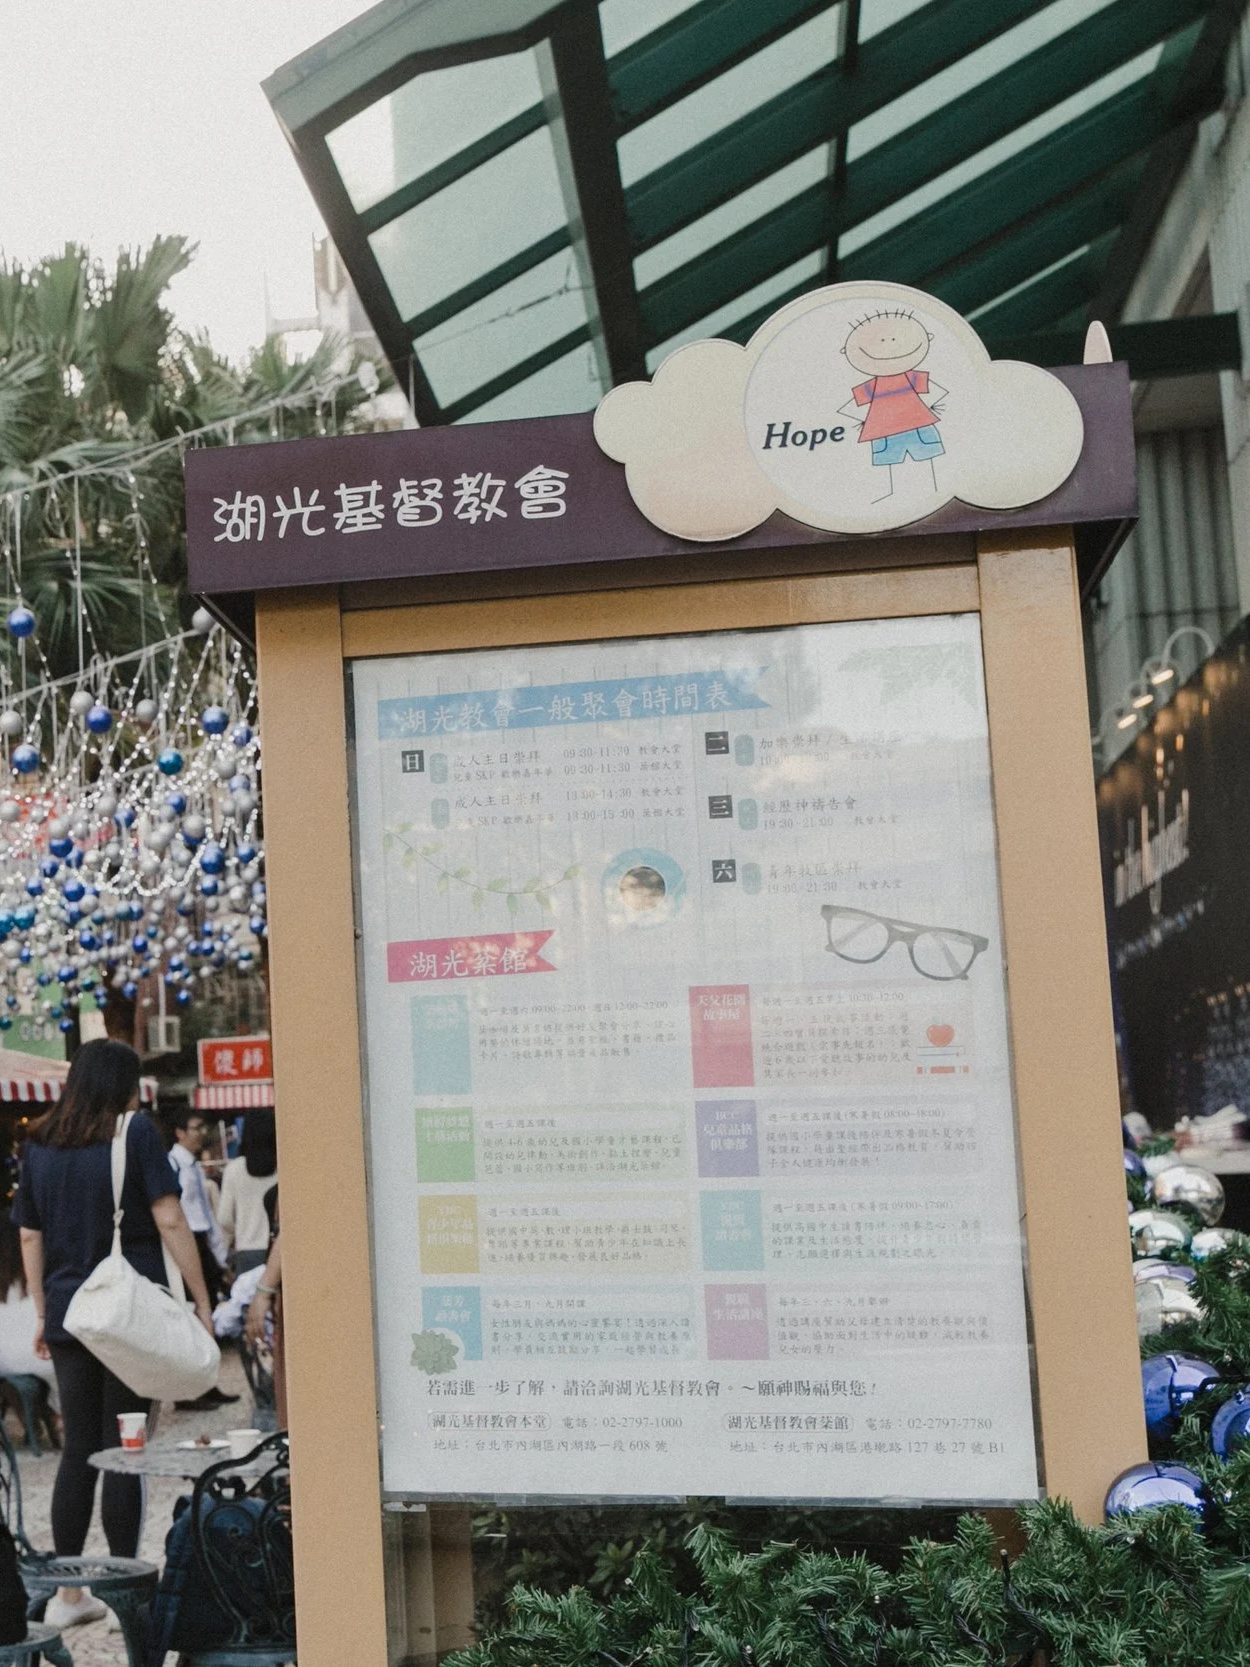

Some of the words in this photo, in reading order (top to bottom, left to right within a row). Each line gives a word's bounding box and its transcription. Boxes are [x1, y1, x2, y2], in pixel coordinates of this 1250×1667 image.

[761, 420, 846, 452] Hope
[213, 465, 571, 545] 湖光基督教會
[399, 681, 732, 735] 湖光教會一般聚會時間表
[432, 1413, 547, 1429] 湖光基督教會本堂
[629, 1439, 651, 1452] 608
[906, 1441, 929, 1453] 127
[951, 1441, 966, 1453] 27
